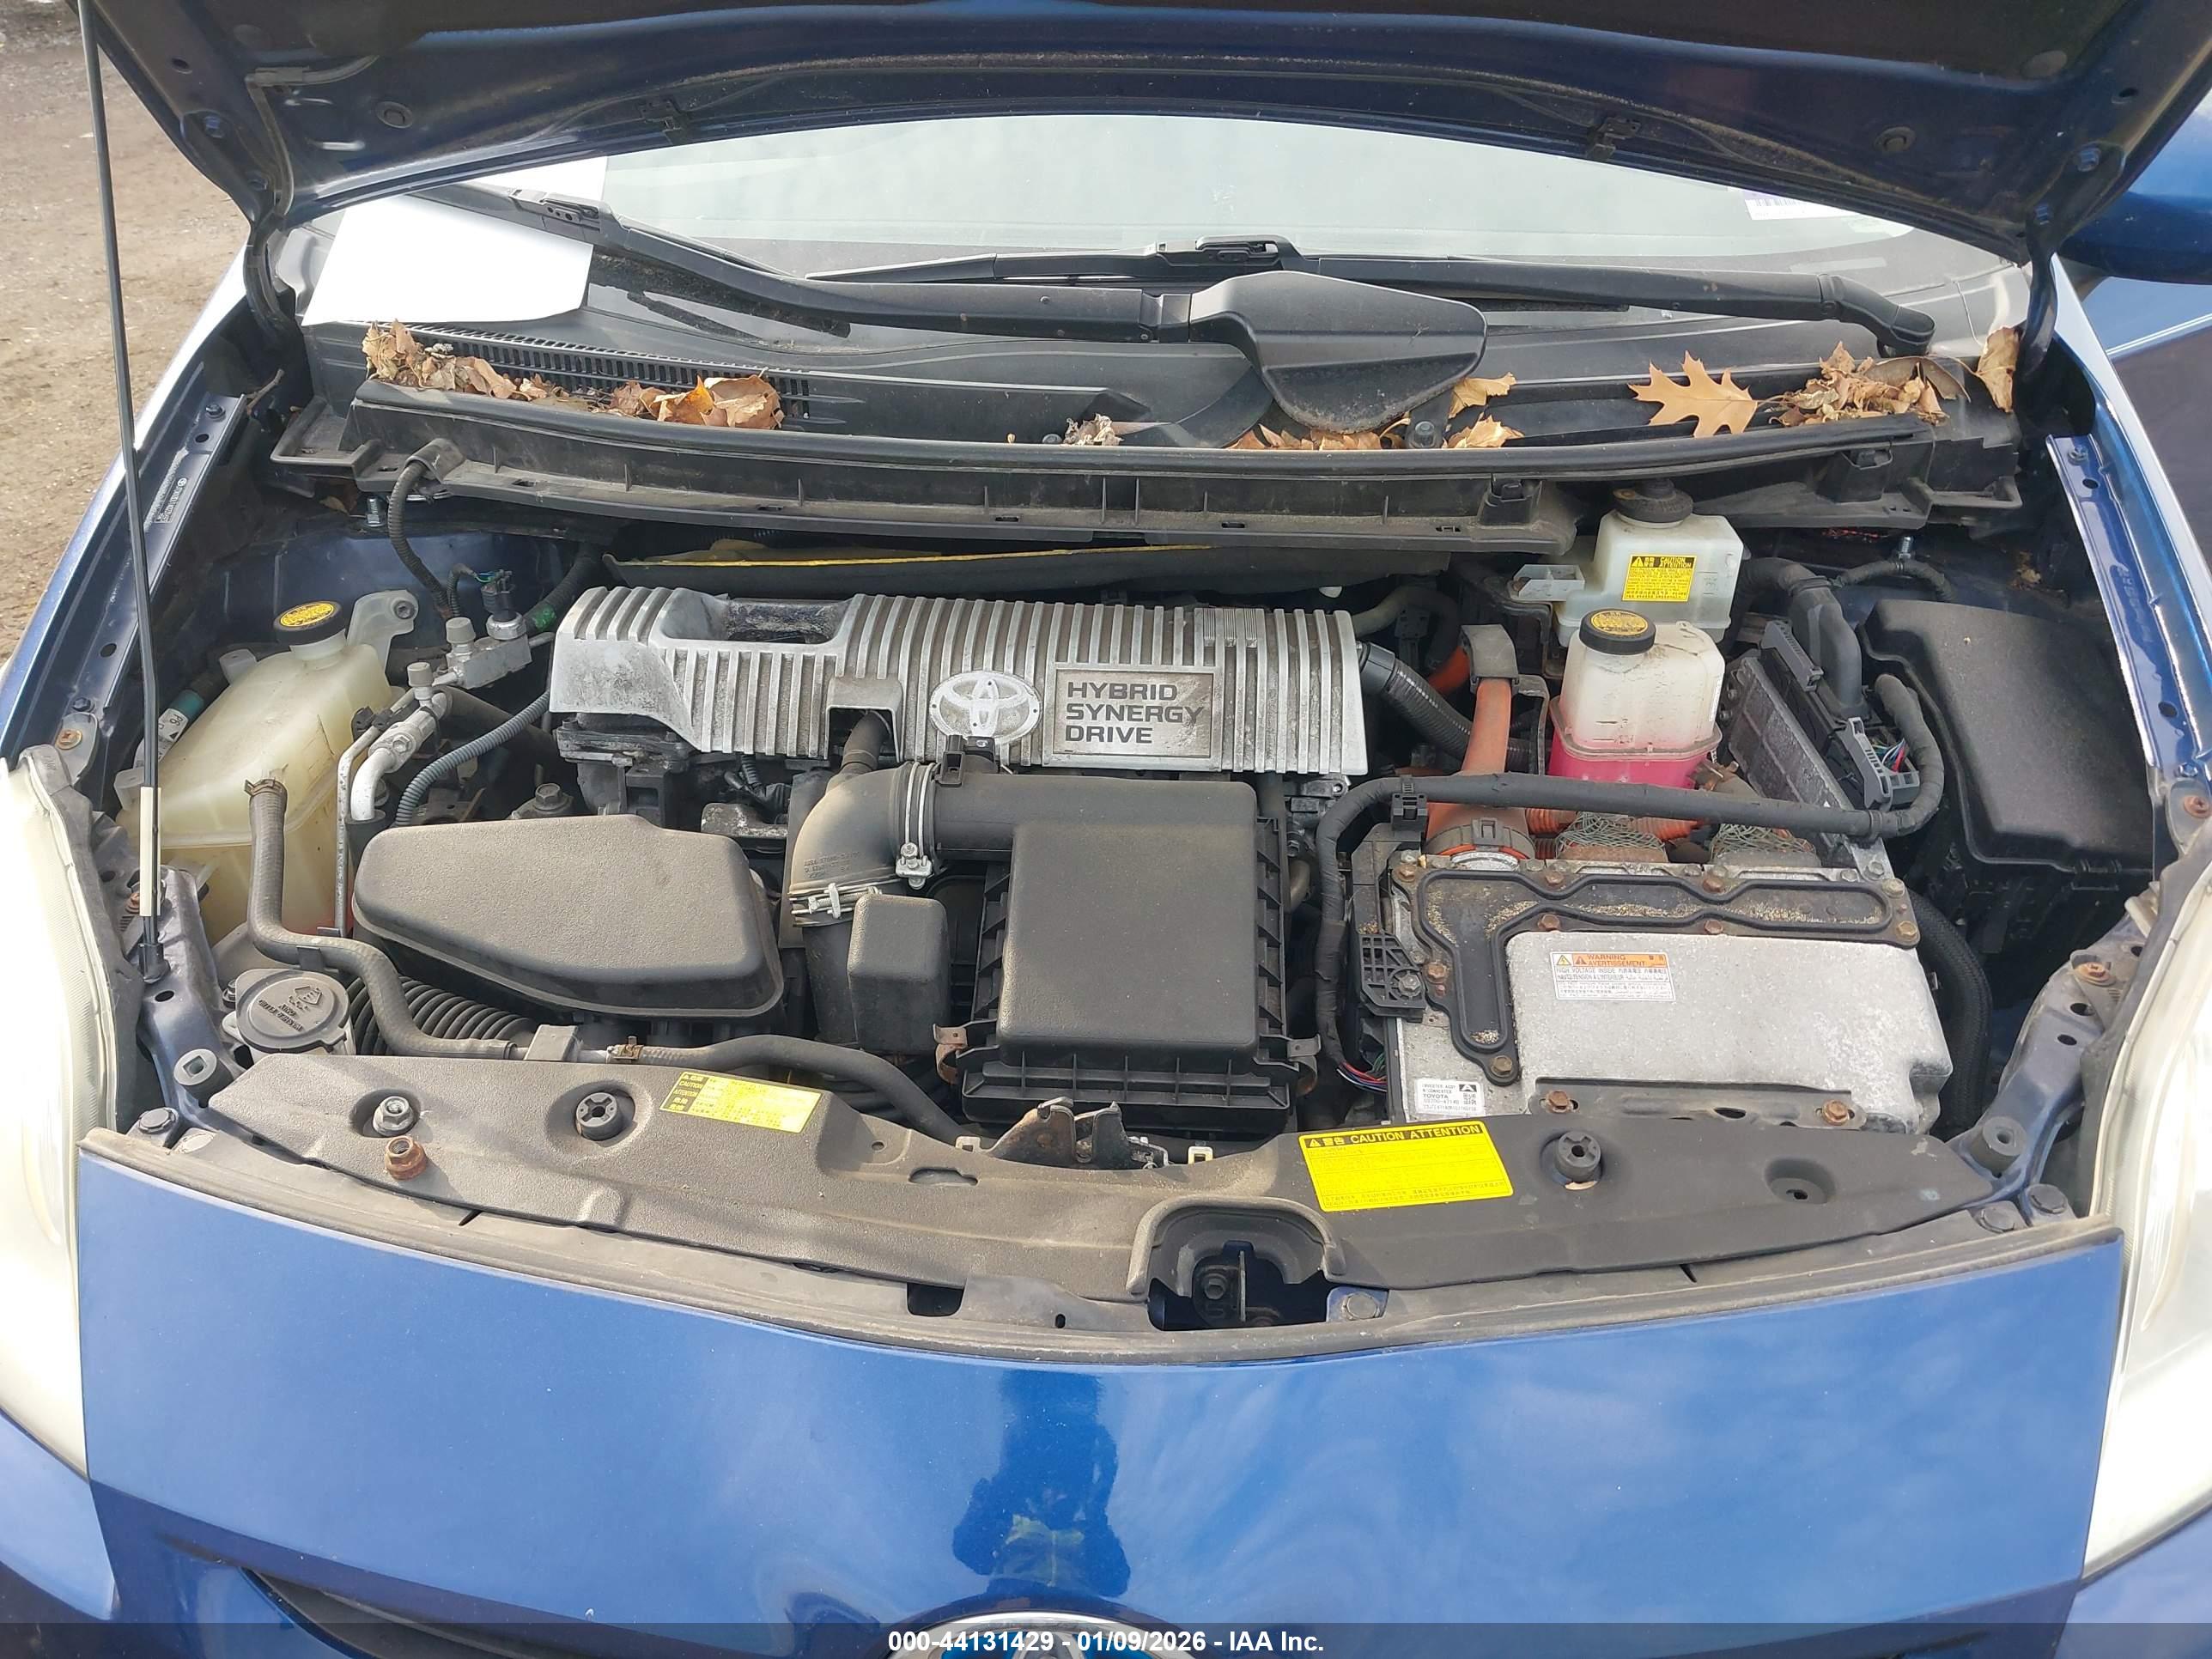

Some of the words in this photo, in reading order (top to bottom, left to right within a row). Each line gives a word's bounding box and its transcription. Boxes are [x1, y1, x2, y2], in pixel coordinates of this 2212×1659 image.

[1067, 681, 1178, 701] HYBRID
[1066, 702, 1205, 724] SYNERGY
[1065, 725, 1154, 744] DRIVE
[678, 1080, 704, 1090] CAUTION
[1350, 1131, 1405, 1144] CAUTION
[1410, 1125, 1481, 1139] ATTENTION
